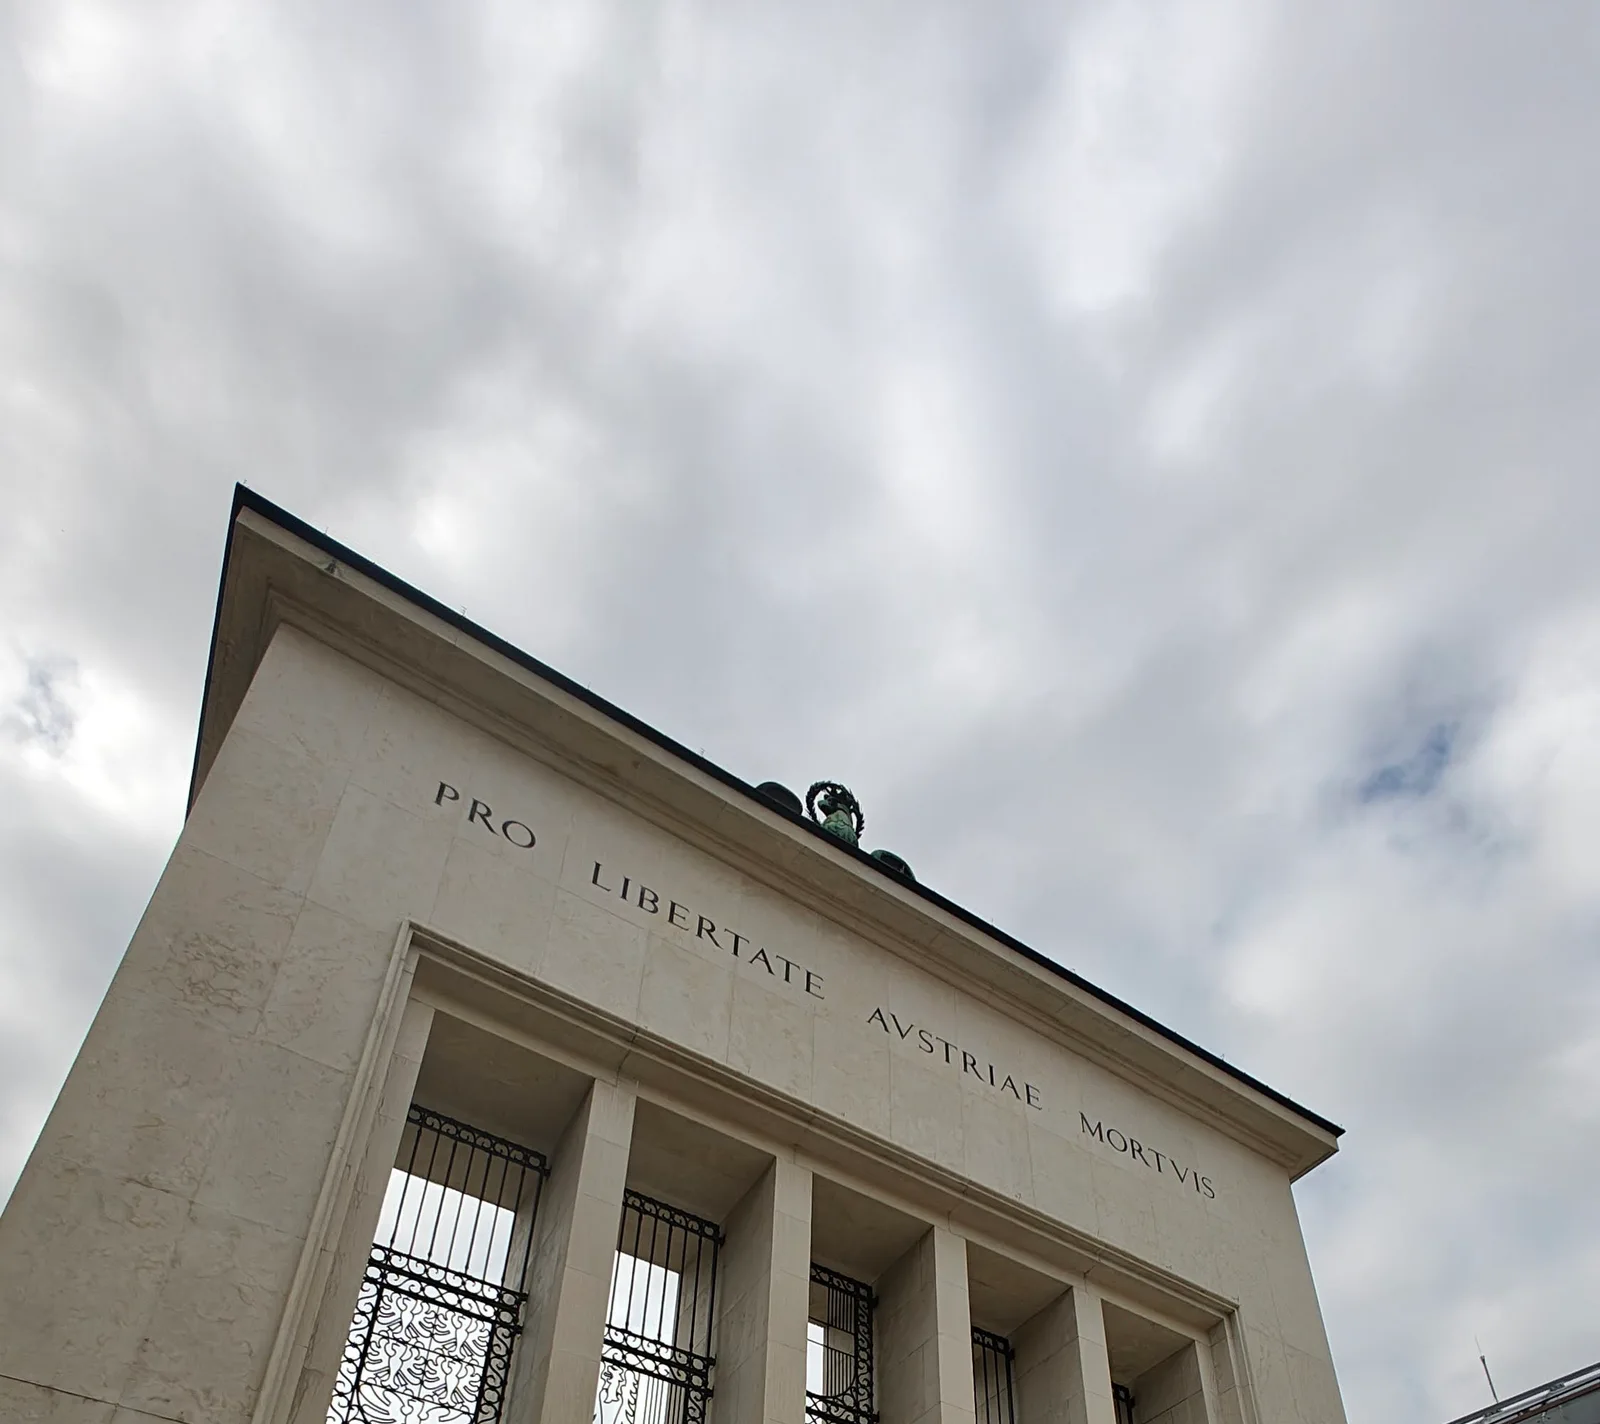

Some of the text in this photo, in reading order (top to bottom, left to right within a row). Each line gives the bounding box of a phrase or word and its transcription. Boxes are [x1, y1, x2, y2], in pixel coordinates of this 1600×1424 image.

[434, 781, 1216, 1200] PRO LIBERTATE AVSTRIAE MORTVIS
